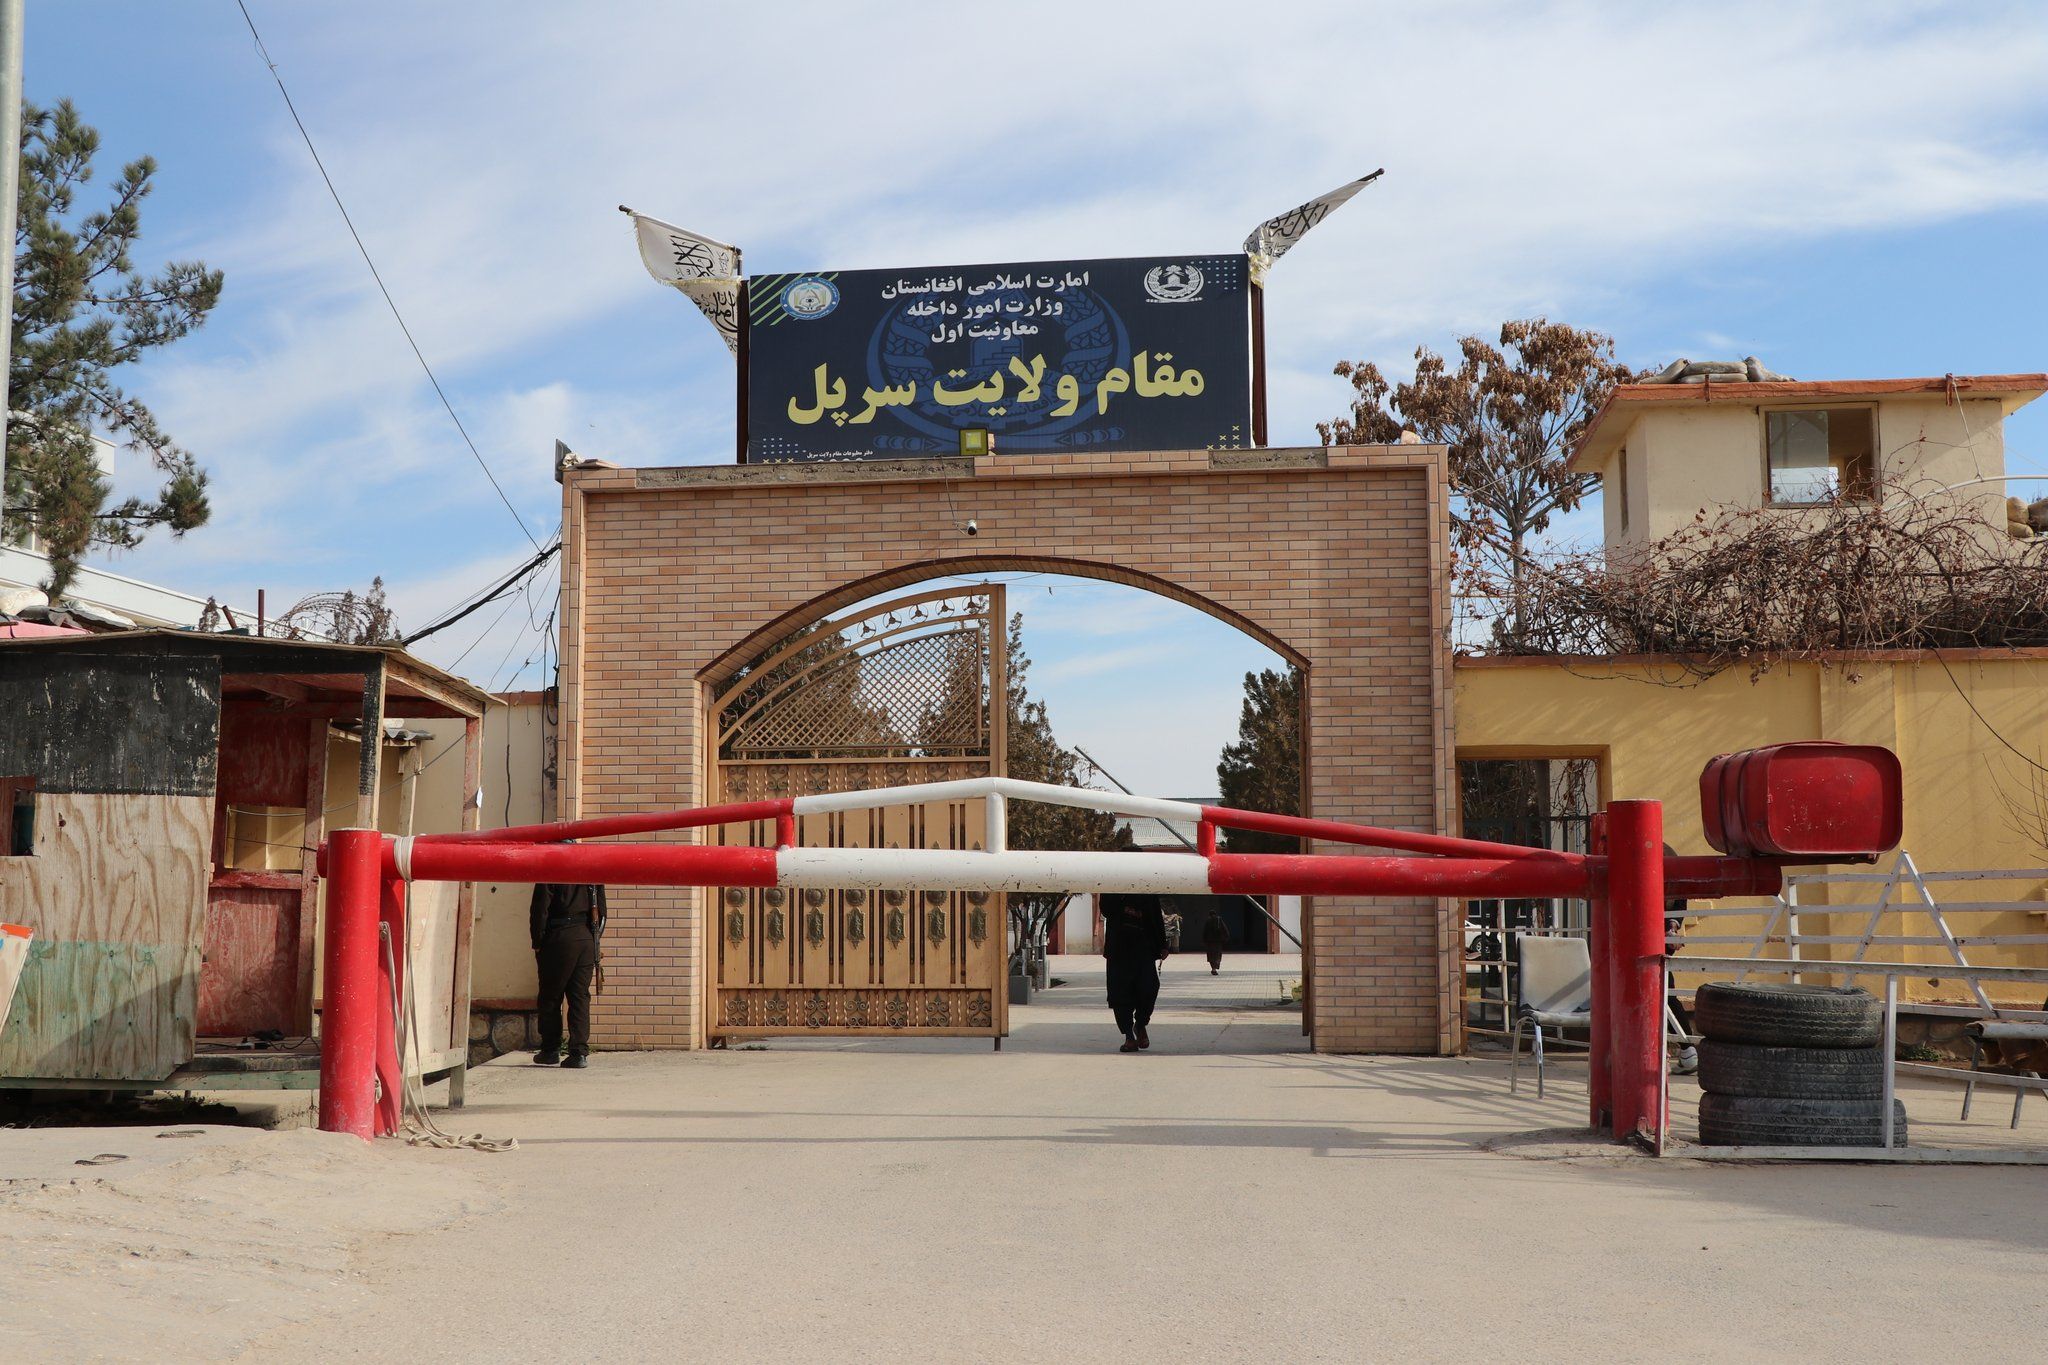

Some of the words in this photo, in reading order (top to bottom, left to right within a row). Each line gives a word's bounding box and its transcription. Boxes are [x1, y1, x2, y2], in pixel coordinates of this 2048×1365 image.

[881, 276, 964, 300] افغانستان
[967, 273, 1032, 296] اسلامی
[1036, 270, 1090, 293] امارت
[906, 300, 958, 317] داخله
[962, 298, 1001, 320] امور
[1005, 296, 1064, 317] وزارت
[930, 323, 964, 344] اول
[967, 320, 1040, 342] معاونیت
[933, 353, 1079, 416] ولایت
[1097, 351, 1206, 414] مقام
